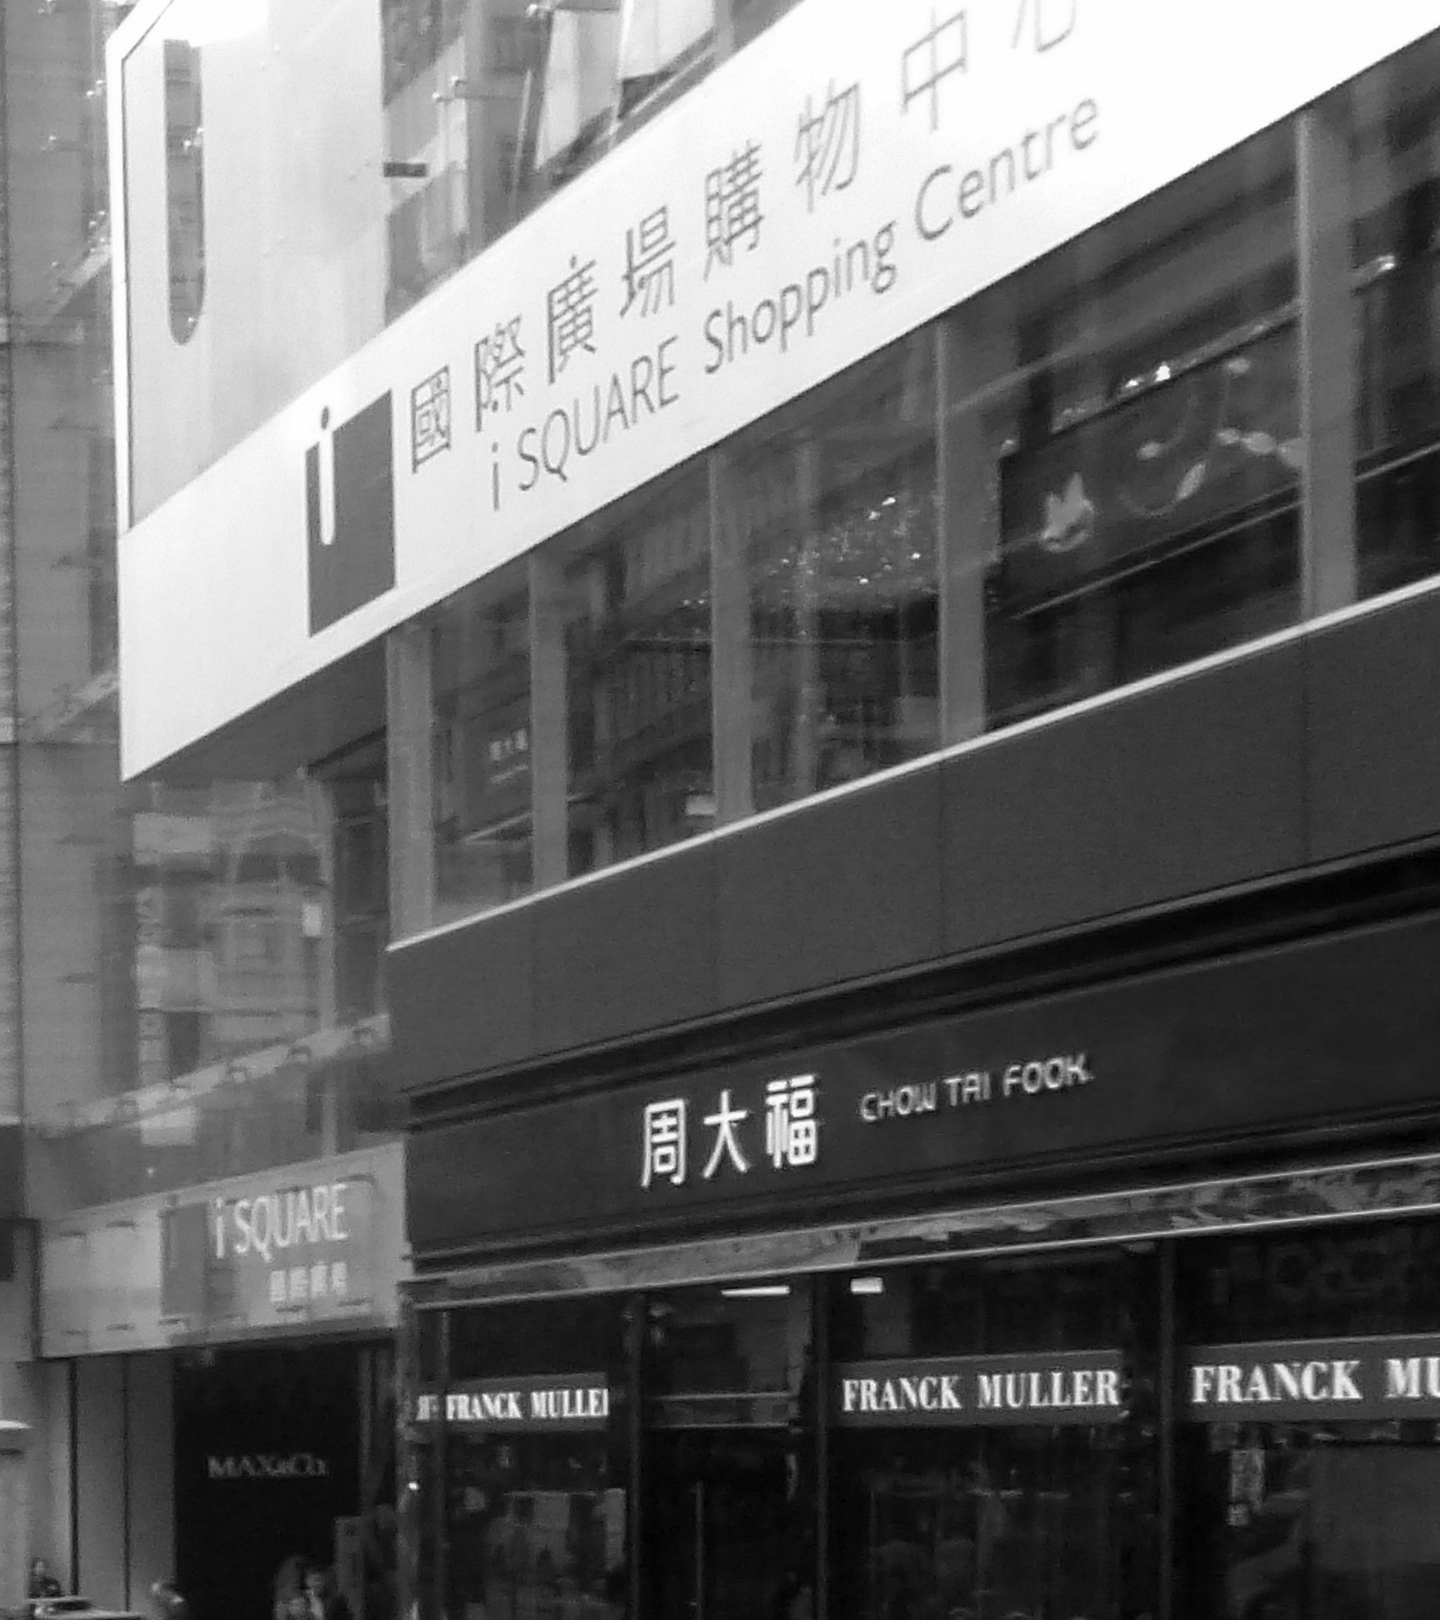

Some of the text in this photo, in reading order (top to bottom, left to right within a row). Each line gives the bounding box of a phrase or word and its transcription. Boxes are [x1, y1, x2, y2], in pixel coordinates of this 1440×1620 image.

[518, 336, 681, 492] SQUARE
[703, 219, 899, 376] Shopping
[914, 97, 1099, 243] Centre
[859, 1052, 1092, 1123] CHOW TAI FOOK
[639, 1073, 818, 1189] 周大福
[234, 1183, 349, 1263] SQUARE
[446, 1392, 522, 1420] FRANCK
[531, 1388, 609, 1418] MULLE
[841, 1368, 1120, 1412] FRANCK MULLER
[1191, 1360, 1364, 1403] FRANCK
